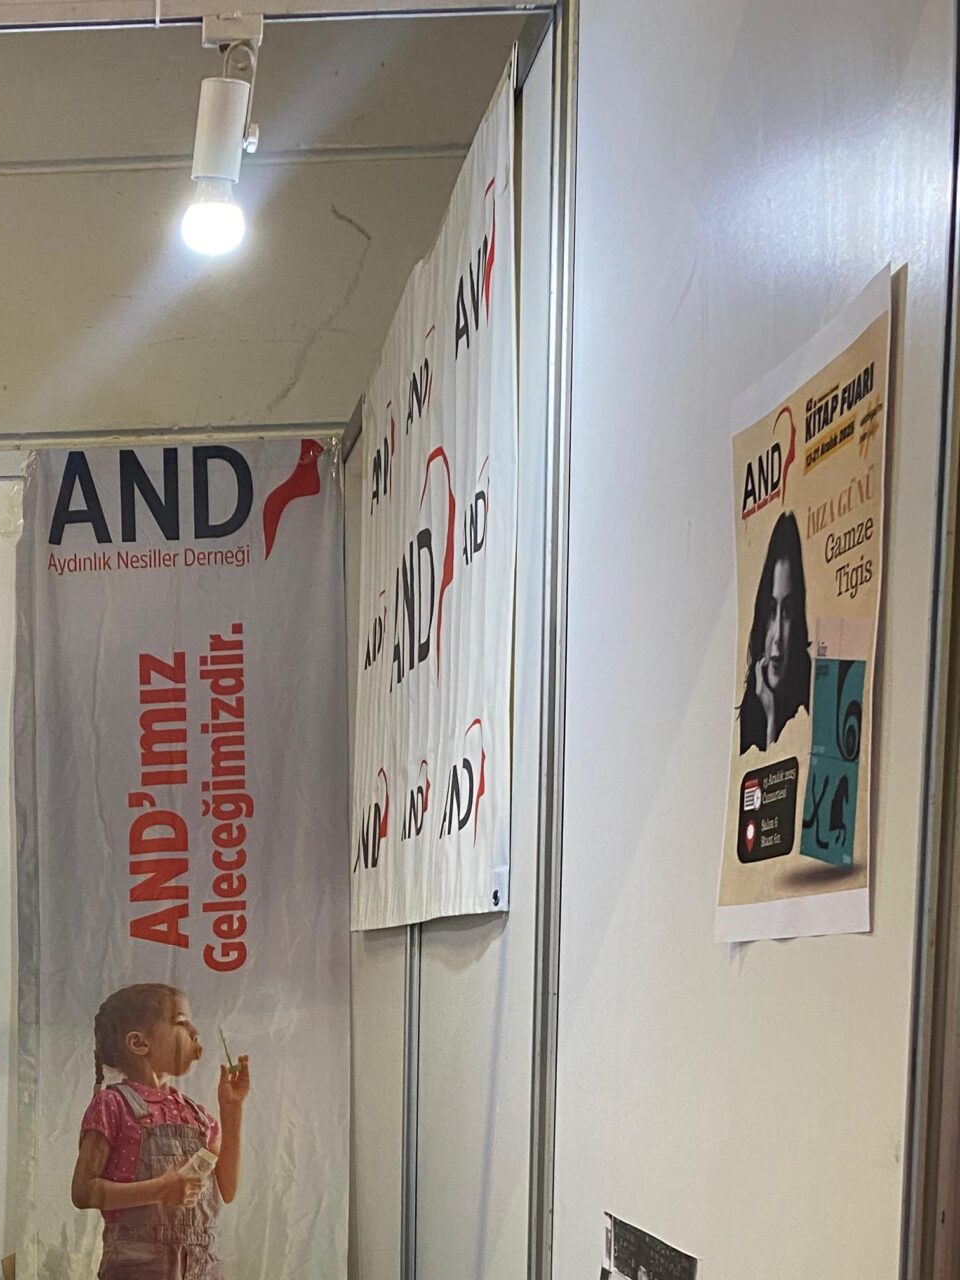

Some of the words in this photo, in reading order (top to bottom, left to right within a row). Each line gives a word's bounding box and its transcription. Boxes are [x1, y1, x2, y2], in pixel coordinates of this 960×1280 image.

[49, 444, 254, 546] AND
[742, 442, 782, 513] AND
[47, 551, 112, 576] Aydınlık
[116, 549, 179, 570] Nesiller
[184, 545, 251, 568] Derneği
[824, 517, 874, 564] Gamze
[835, 554, 873, 600] Tigis
[198, 622, 255, 973] Geleceğimizdir.
[440, 757, 474, 840] AND
